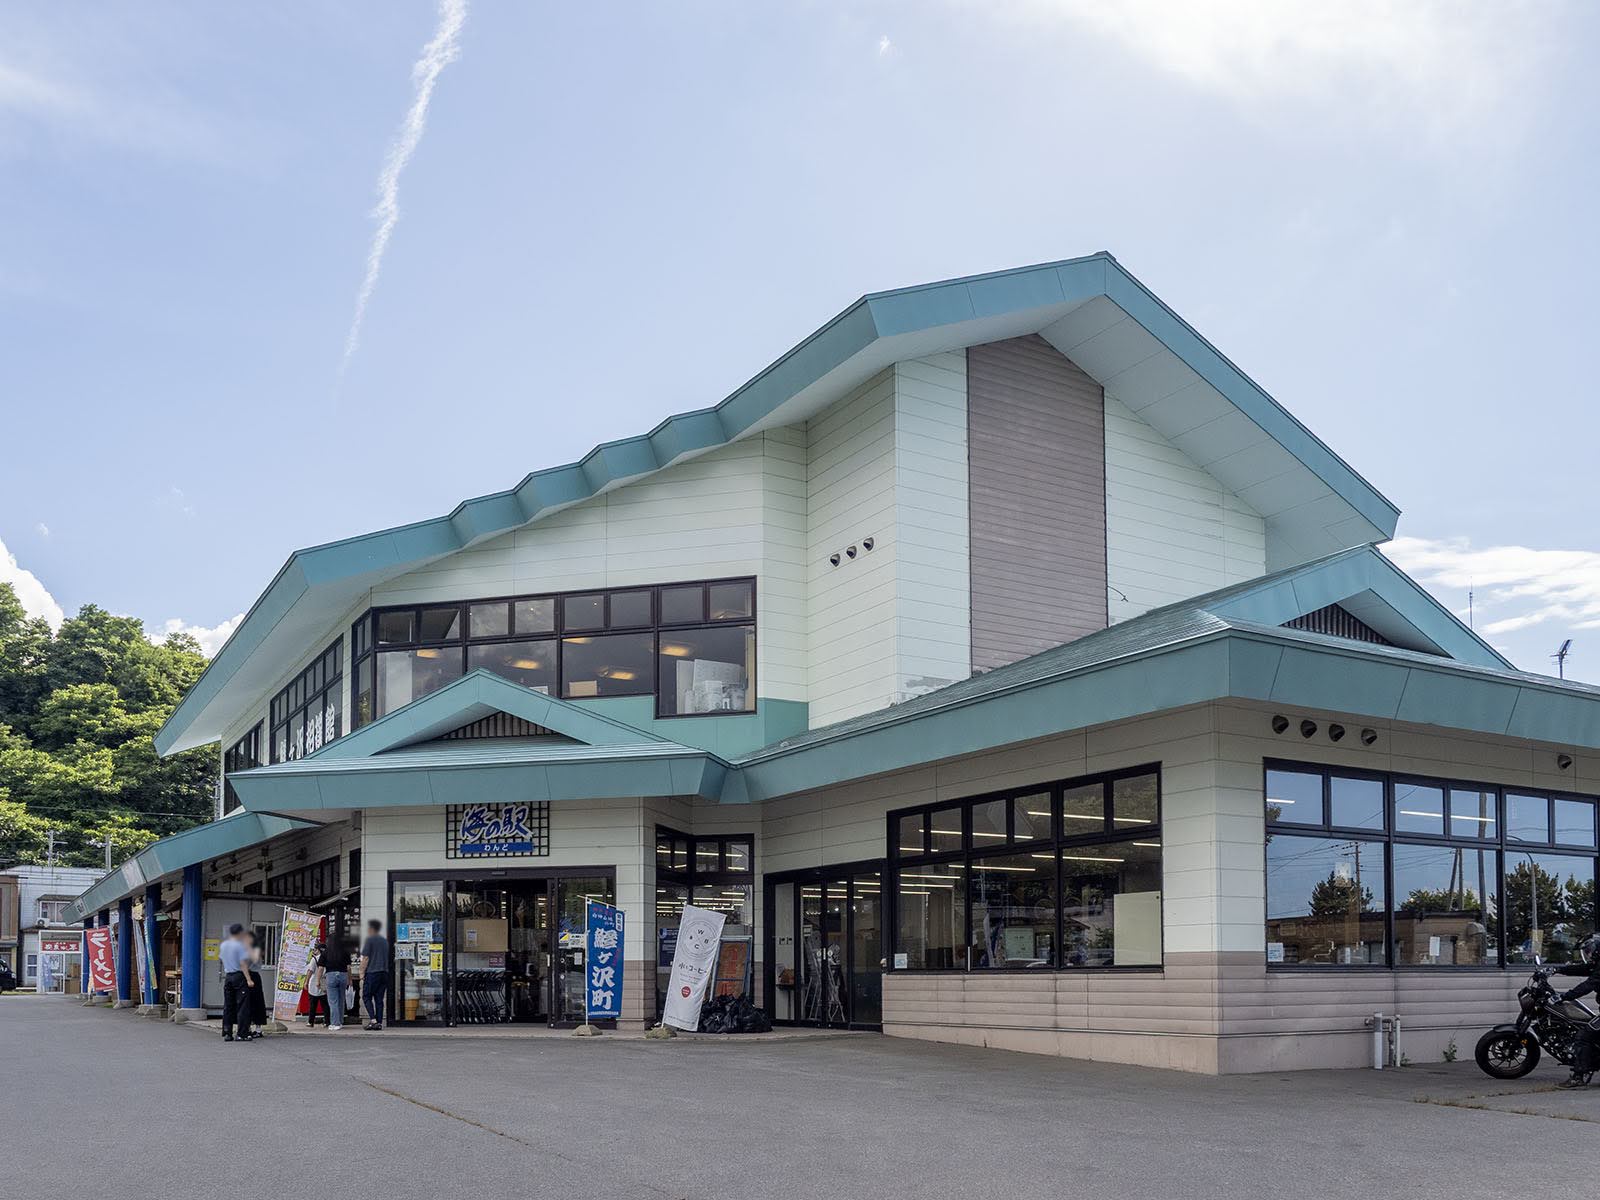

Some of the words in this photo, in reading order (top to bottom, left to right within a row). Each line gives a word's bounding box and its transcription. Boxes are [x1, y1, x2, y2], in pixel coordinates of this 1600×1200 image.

[460, 805, 534, 842] 海の駅
[484, 844, 509, 852] わんど
